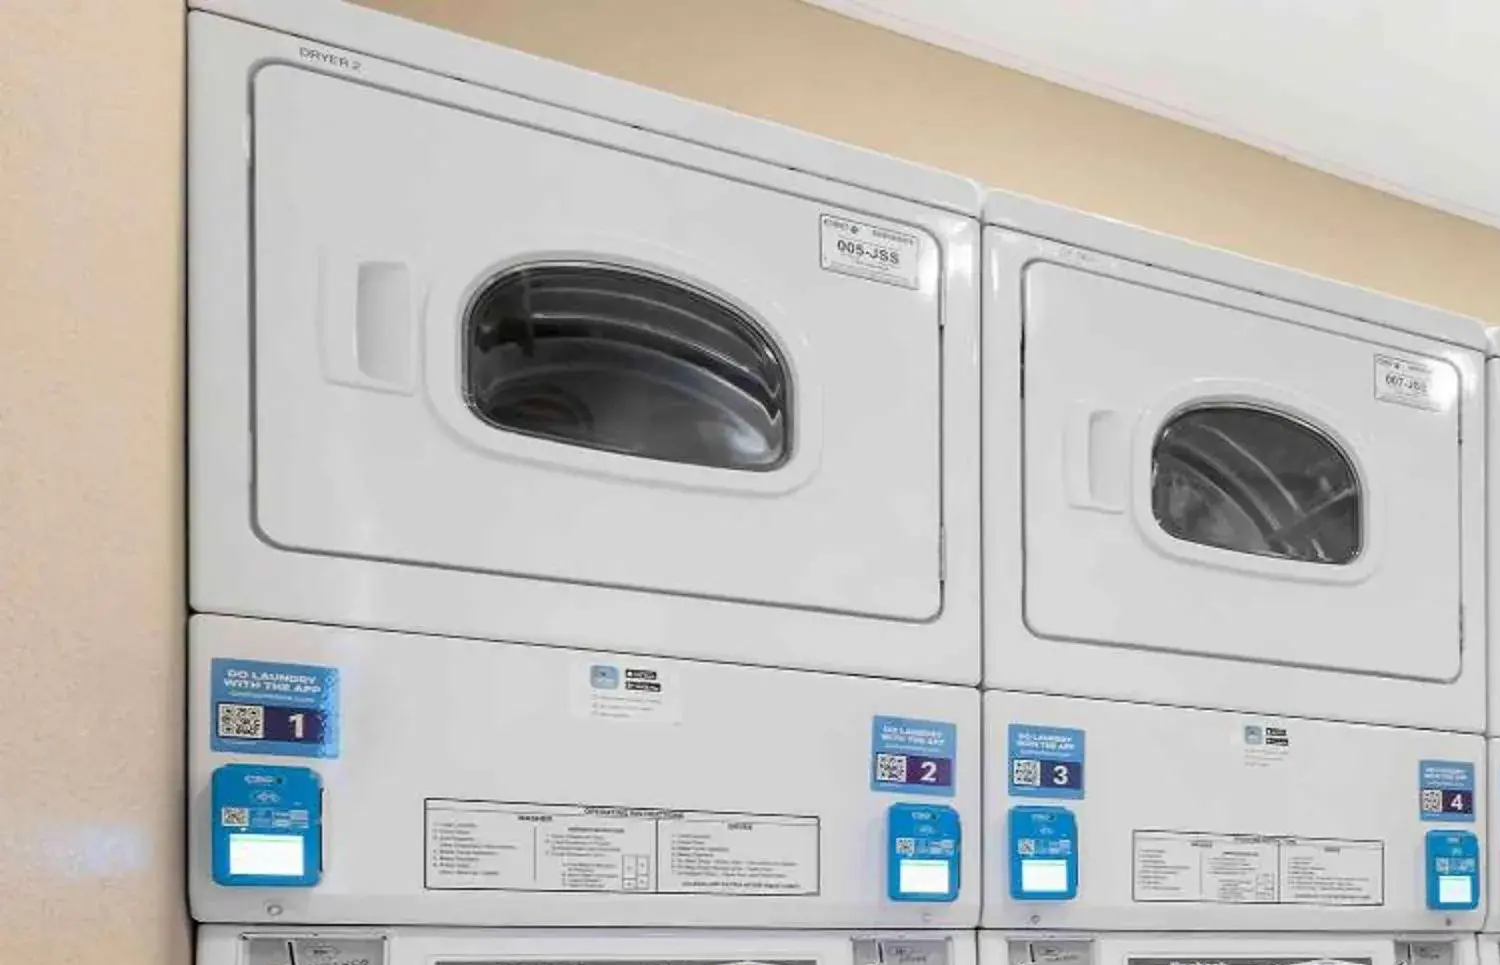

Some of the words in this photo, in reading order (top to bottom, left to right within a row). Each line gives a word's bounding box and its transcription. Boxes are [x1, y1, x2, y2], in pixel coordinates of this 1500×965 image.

[288, 714, 305, 739] 1
[920, 761, 938, 783] 2
[1053, 765, 1070, 786] 3
[1450, 793, 1464, 812] 4
